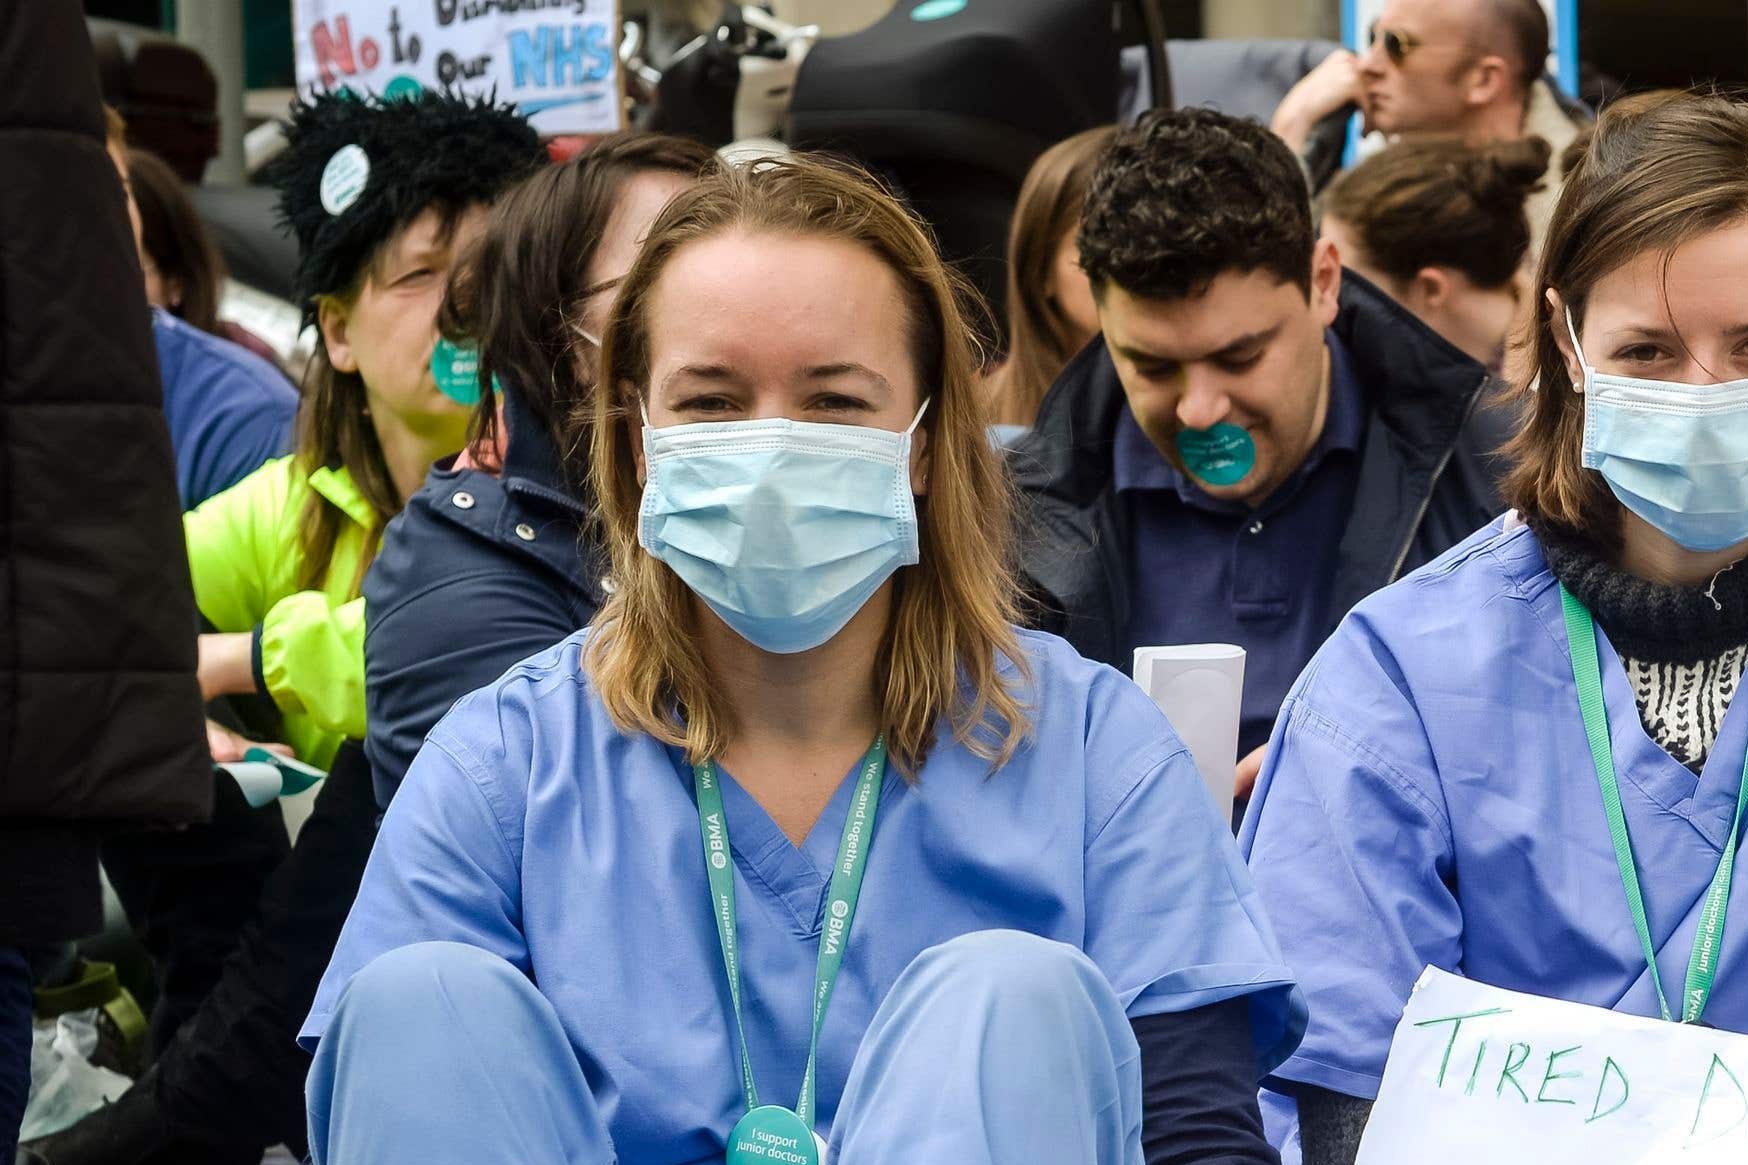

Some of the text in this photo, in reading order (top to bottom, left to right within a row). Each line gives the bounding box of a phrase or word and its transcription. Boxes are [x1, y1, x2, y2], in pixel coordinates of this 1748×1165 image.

[311, 7, 421, 87] No to
[436, 23, 613, 88] Our NHS
[706, 813, 724, 851] BMA
[842, 762, 878, 877] We stand together
[720, 894, 735, 950] together
[825, 918, 844, 955] BMA
[818, 981, 828, 998] We
[1413, 1007, 1632, 1125] TIRED
[736, 1138, 807, 1165] junior doctors
[752, 1128, 798, 1149] I support
